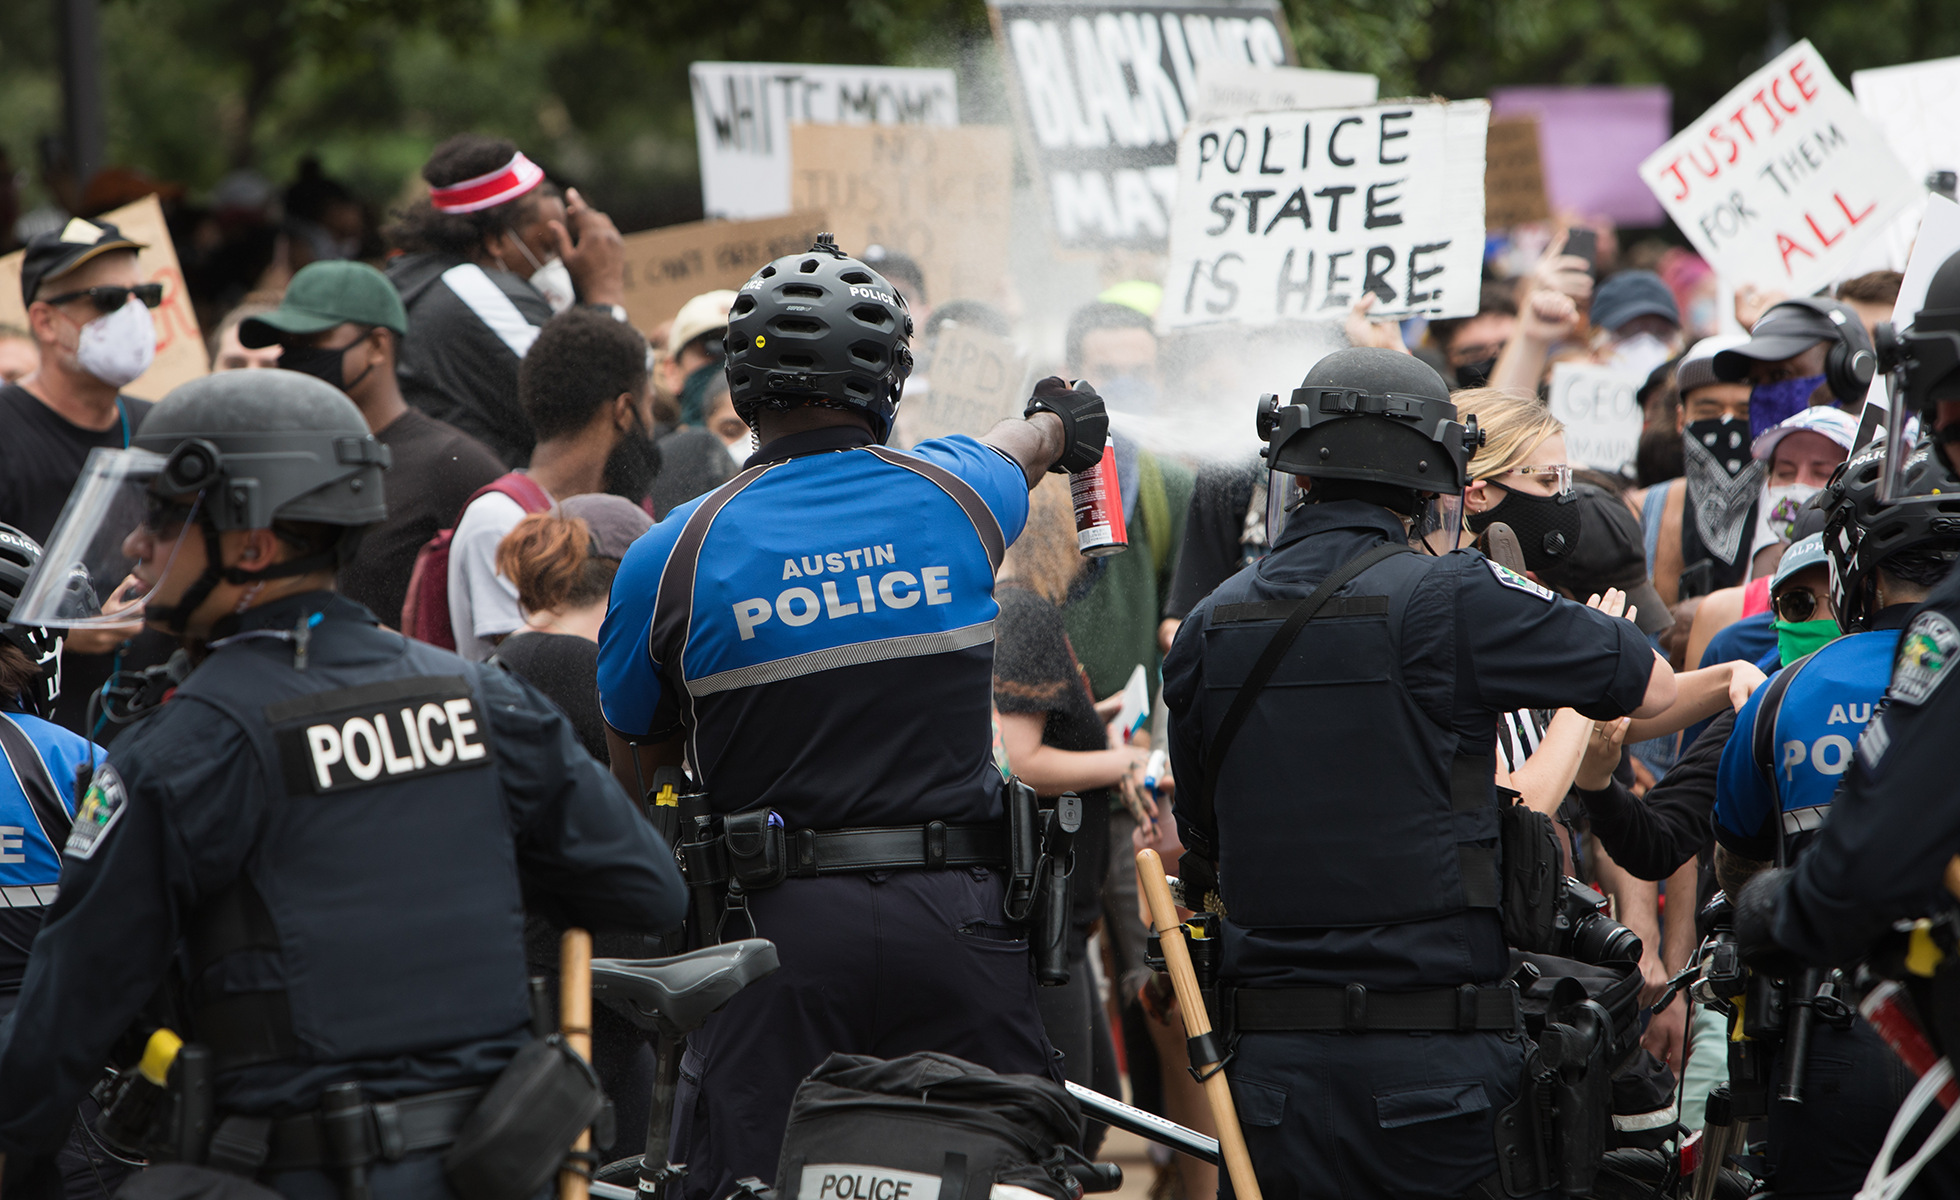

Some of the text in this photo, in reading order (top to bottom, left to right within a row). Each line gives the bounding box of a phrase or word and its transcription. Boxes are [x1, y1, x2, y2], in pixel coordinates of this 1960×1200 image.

[1009, 11, 1188, 147] BLACK
[1198, 111, 1412, 181] POLICE
[1659, 59, 1819, 202] JUSTICE
[1206, 178, 1408, 236] STATE
[1700, 122, 1847, 250] FOR THEM
[1776, 192, 1878, 278] ALL
[849, 286, 895, 307] POLICE
[1184, 241, 1452, 315] IS HERE
[1561, 373, 1639, 424] GEO
[1849, 450, 1886, 469] POLIC
[0, 533, 41, 557] OLICE
[782, 544, 895, 580] AUSTIN
[732, 566, 952, 641] POLICE
[306, 698, 487, 789] POLICE
[820, 1174, 912, 1200] POLICE
